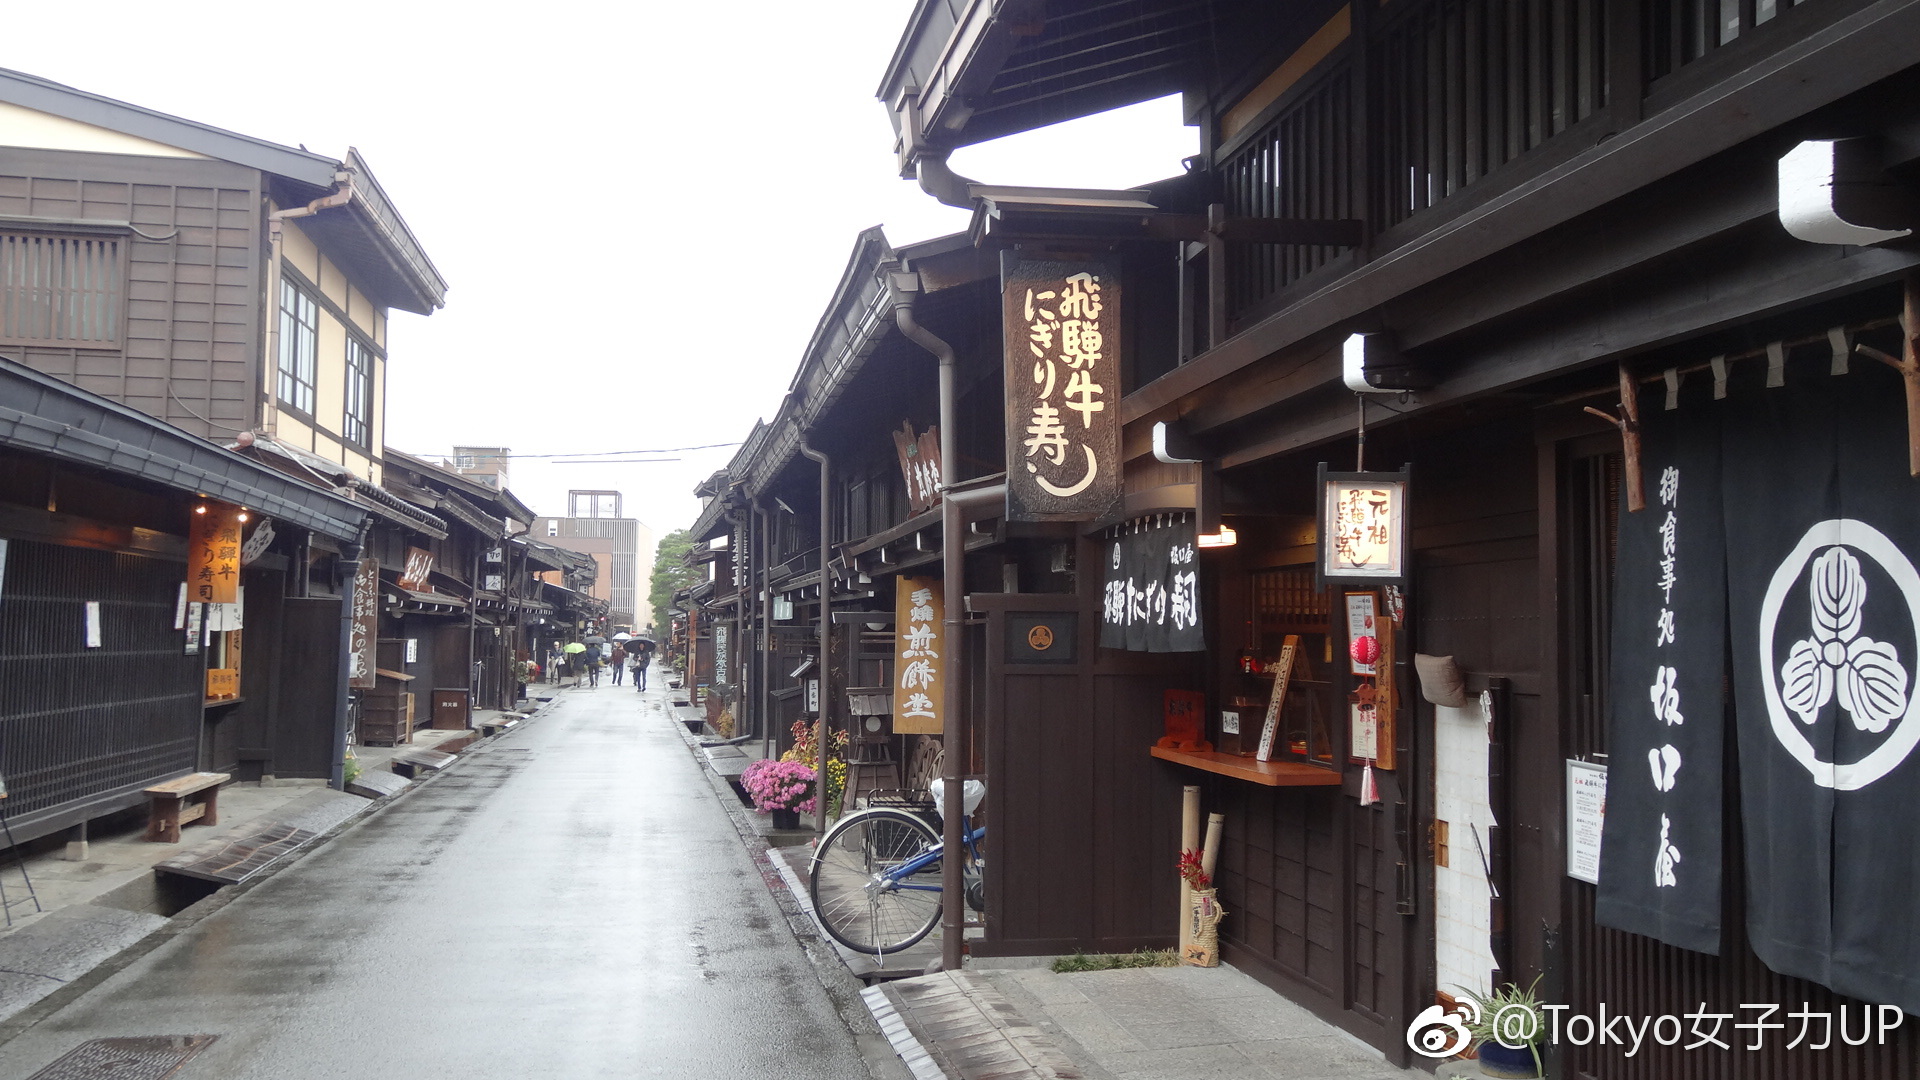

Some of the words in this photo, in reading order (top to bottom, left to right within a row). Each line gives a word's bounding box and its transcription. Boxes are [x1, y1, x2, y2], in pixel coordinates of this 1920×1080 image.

[1024, 288, 1098, 497] にぎり寿し
[1059, 272, 1104, 429] 飛騨牛
[218, 528, 238, 581] 飛騨牛
[1367, 490, 1389, 545] 元祖
[1657, 466, 1679, 647] 御食事処
[901, 588, 939, 719] 手焼煎餅堂
[1648, 666, 1684, 888] 坂口屋
